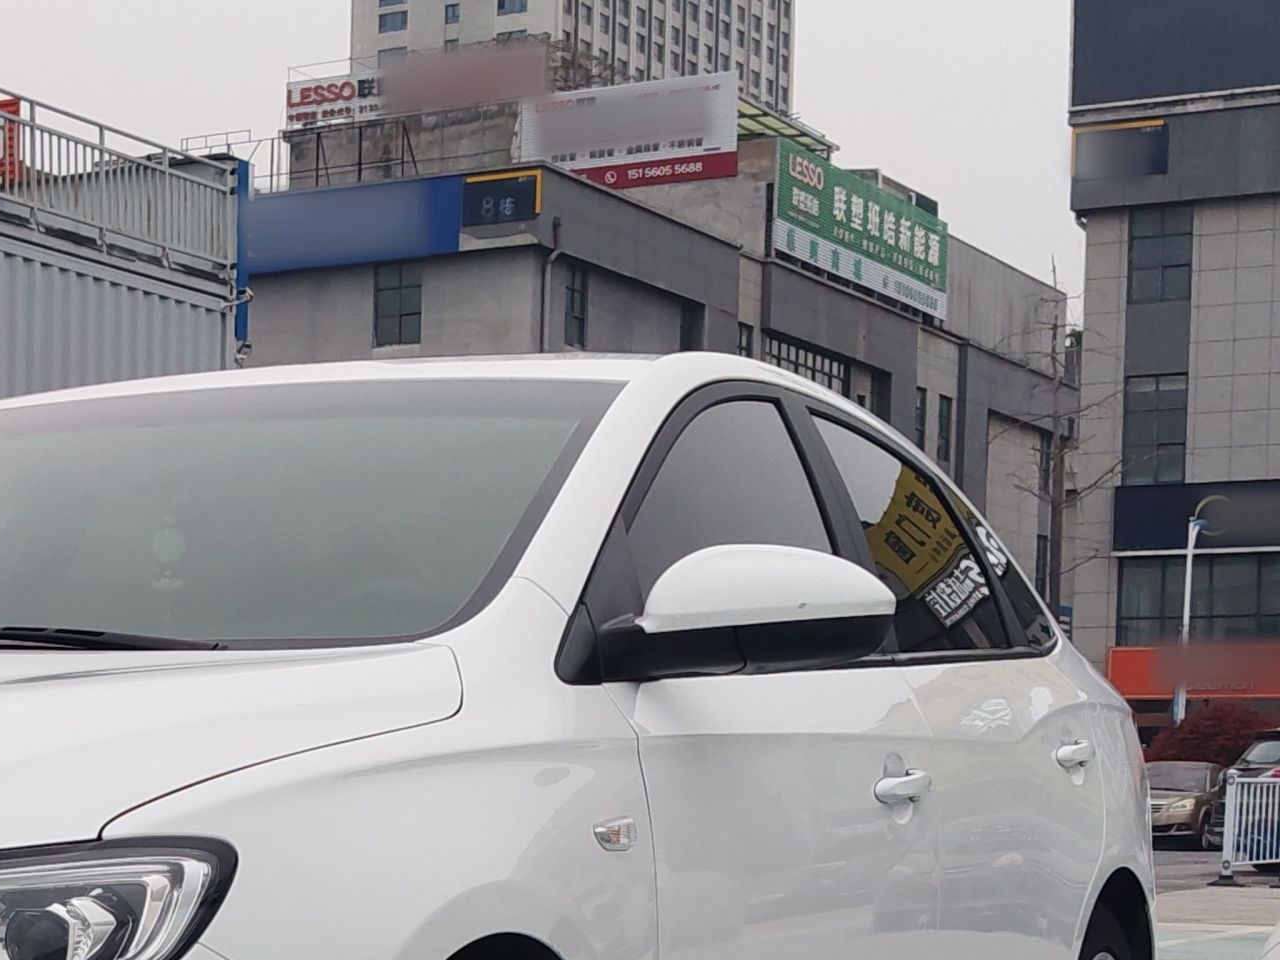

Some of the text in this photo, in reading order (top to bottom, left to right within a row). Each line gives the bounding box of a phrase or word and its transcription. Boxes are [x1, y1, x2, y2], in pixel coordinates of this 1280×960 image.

[287, 80, 356, 108] LESSO
[627, 161, 703, 179] 151 5605 5688
[789, 153, 825, 190] LESSO
